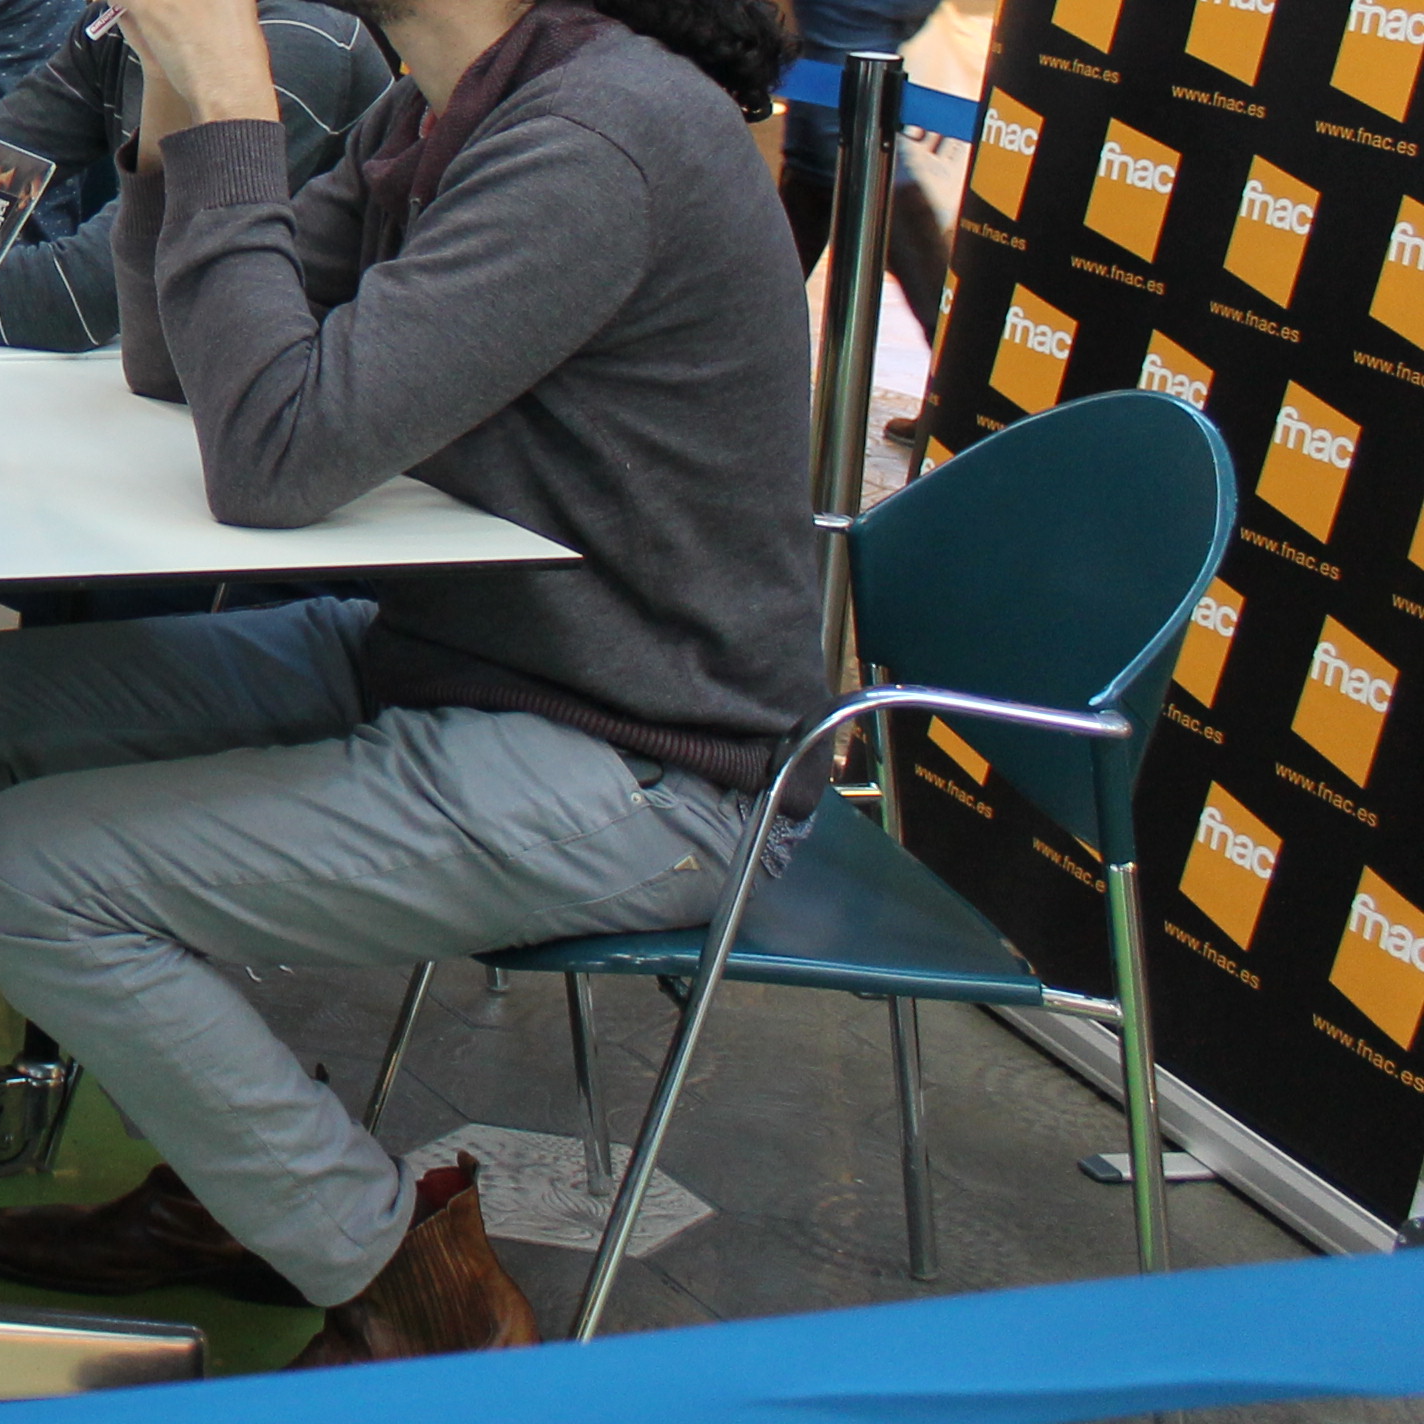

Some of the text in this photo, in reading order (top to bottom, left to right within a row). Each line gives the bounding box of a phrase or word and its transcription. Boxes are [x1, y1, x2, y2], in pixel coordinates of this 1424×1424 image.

[1038, 53, 1121, 85] www.fnac.es
[1171, 86, 1267, 120] www.fnac.es
[980, 106, 1040, 156] fnac
[1314, 120, 1419, 158] www.fnac.es
[1098, 140, 1176, 194] fnac
[1239, 178, 1315, 235] fnac
[1070, 256, 1166, 297] www.fnac.es
[1003, 305, 1073, 360] fnac
[1208, 300, 1302, 344] www.fnac.es
[1138, 353, 1208, 410] fnac
[1273, 405, 1356, 469] fnac
[1239, 527, 1341, 582] www.fnac.es
[1310, 641, 1394, 713] fnac
[914, 764, 994, 820] www.fnac.es
[1274, 763, 1379, 829] www.fnac.es
[1032, 837, 1107, 894] www.fnac.e
[1197, 805, 1277, 880] fnac
[1163, 921, 1261, 991] www.fnac.es
